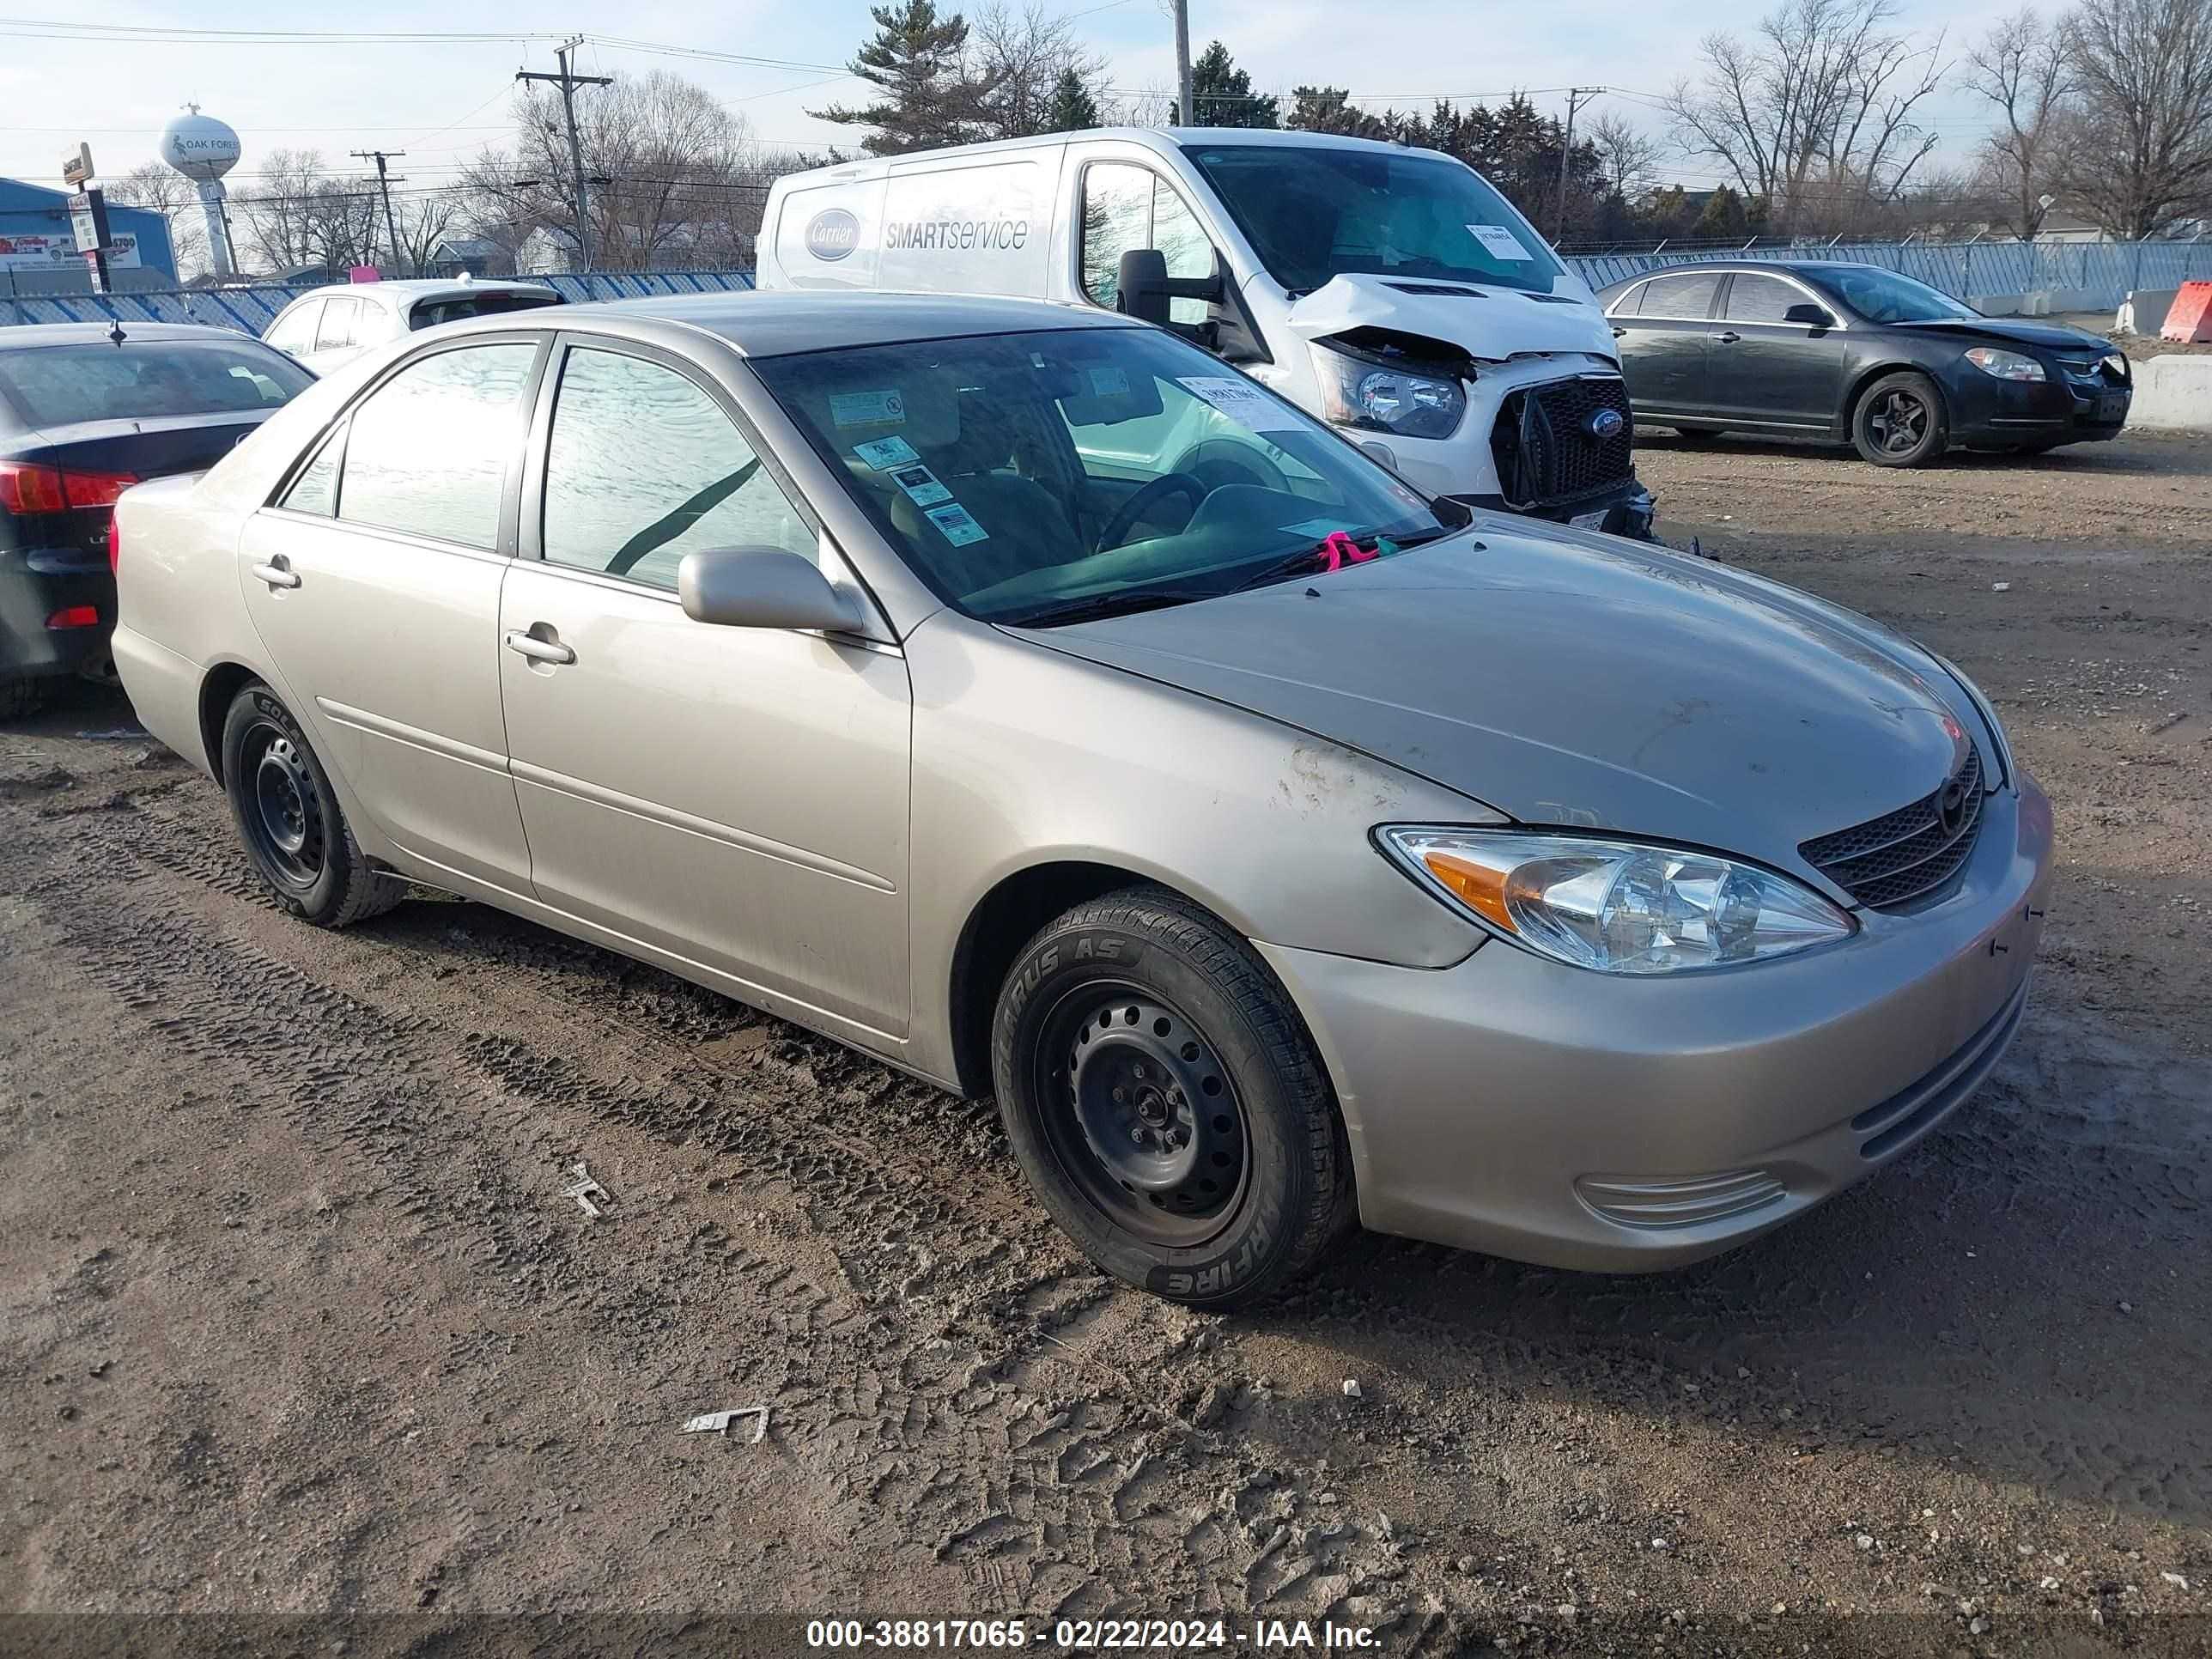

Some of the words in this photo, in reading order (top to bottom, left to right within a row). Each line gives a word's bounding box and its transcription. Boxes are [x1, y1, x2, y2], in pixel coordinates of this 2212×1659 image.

[185, 140, 208, 149] OAK
[811, 222, 853, 243] Carrier
[885, 219, 1029, 251] SMARTservice
[1073, 938, 1127, 960] AS
